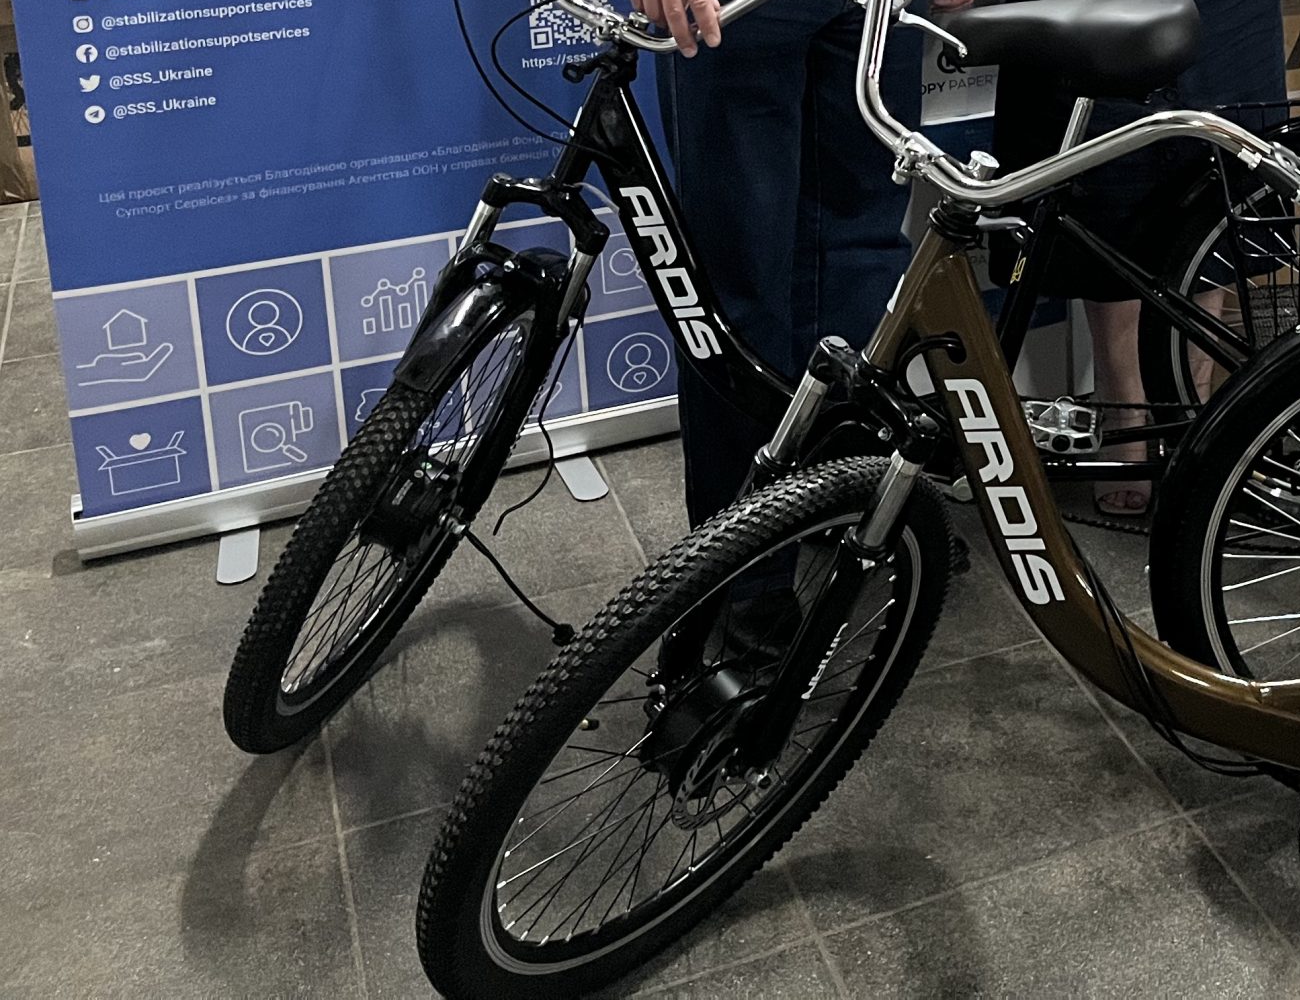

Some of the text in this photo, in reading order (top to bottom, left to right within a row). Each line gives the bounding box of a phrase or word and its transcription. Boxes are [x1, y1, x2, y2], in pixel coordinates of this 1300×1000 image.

[109, 66, 214, 90] @SSS_Ukraine
[921, 74, 994, 96] OPY PAPER
[113, 95, 217, 120] @SSS_Ukraine
[512, 134, 543, 147] Фонд
[116, 204, 171, 219] Суппорт
[412, 164, 439, 176] ООН
[620, 185, 722, 360] ARDIS
[944, 378, 1065, 606] ARDIS
